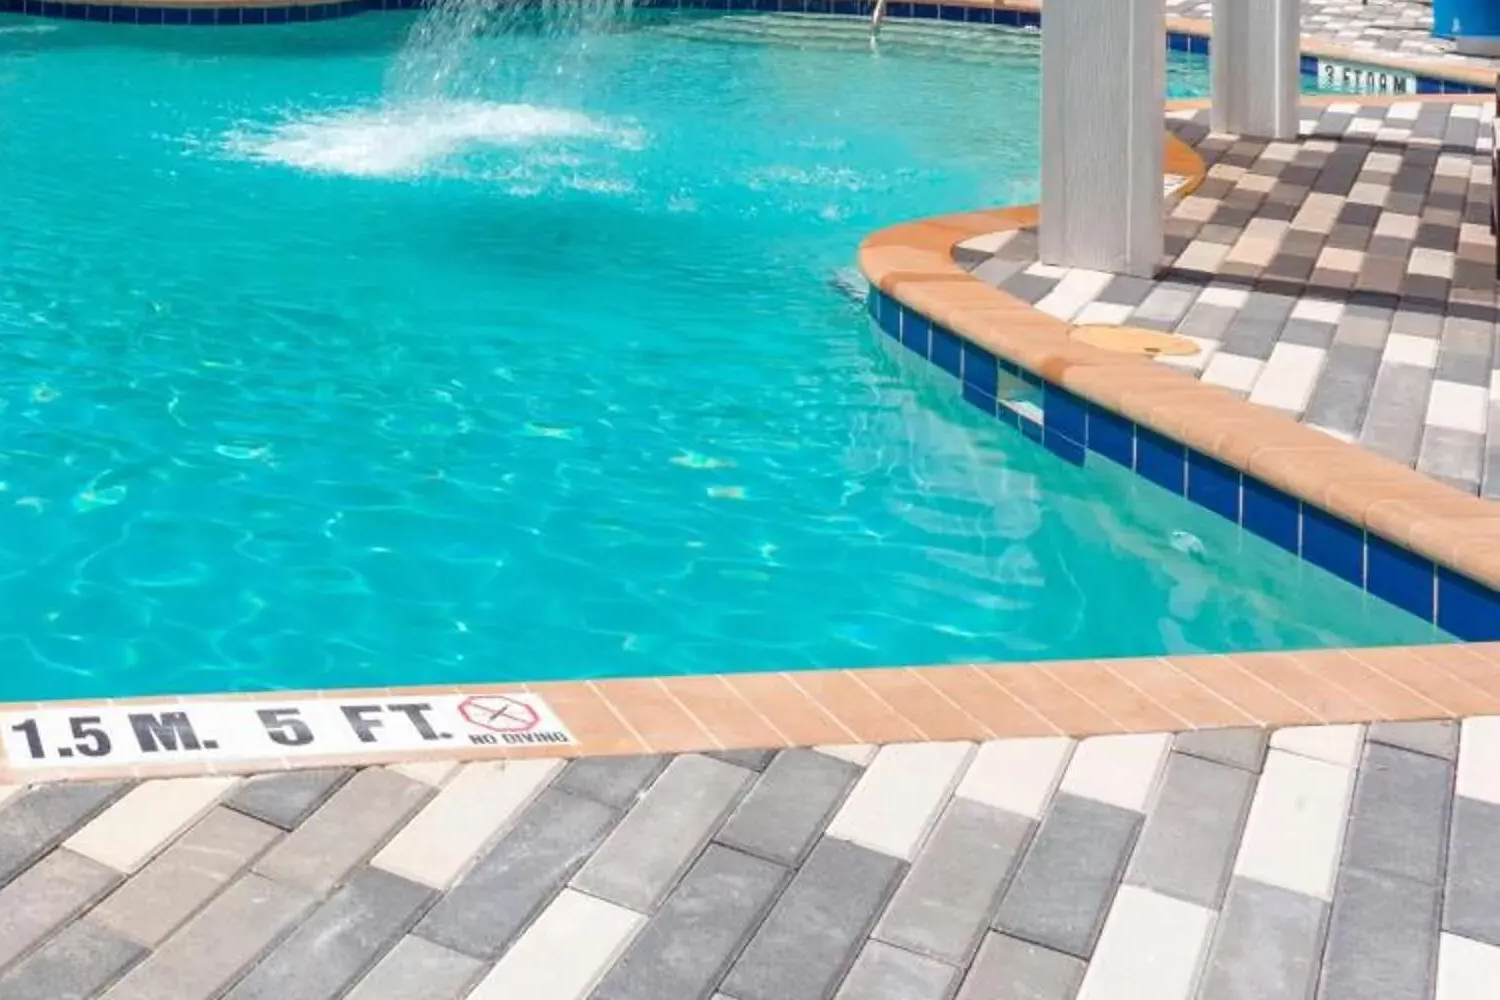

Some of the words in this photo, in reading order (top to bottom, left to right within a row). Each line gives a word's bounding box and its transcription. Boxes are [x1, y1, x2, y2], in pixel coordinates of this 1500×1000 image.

[1367, 71, 1387, 91] 09
[12, 716, 112, 758] 1.5
[128, 711, 219, 753] M.
[257, 708, 314, 746] 5
[340, 703, 454, 743] FT.
[468, 733, 498, 745] NO
[501, 730, 569, 744] DIVING
